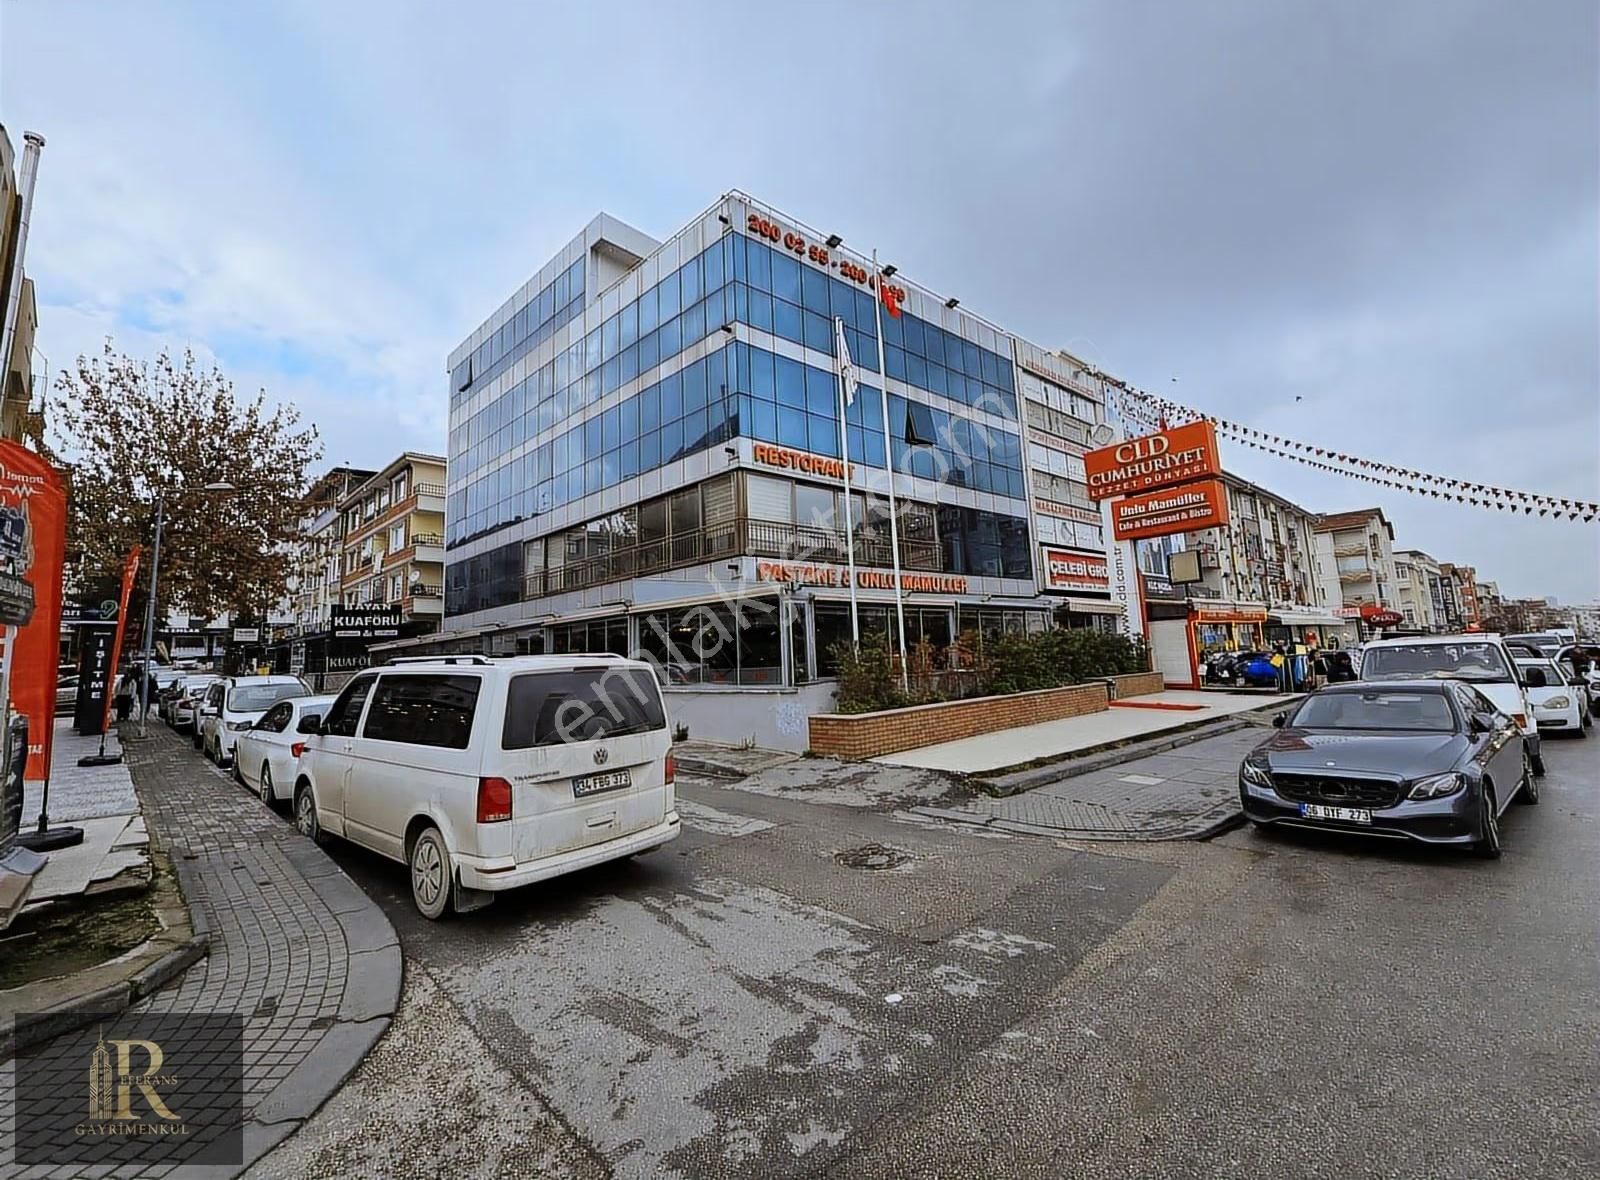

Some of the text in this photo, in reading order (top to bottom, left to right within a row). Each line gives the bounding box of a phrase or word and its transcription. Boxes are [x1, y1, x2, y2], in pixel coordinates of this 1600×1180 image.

[753, 444, 855, 480] RESTORANT
[1115, 435, 1169, 463] CLD
[1089, 447, 1205, 486] CUMHURİYET
[1091, 481, 1138, 497] LEZZET
[758, 561, 837, 587] PASTANE
[1050, 560, 1087, 577] ÇELEBİ
[1349, 809, 1369, 821] 273
